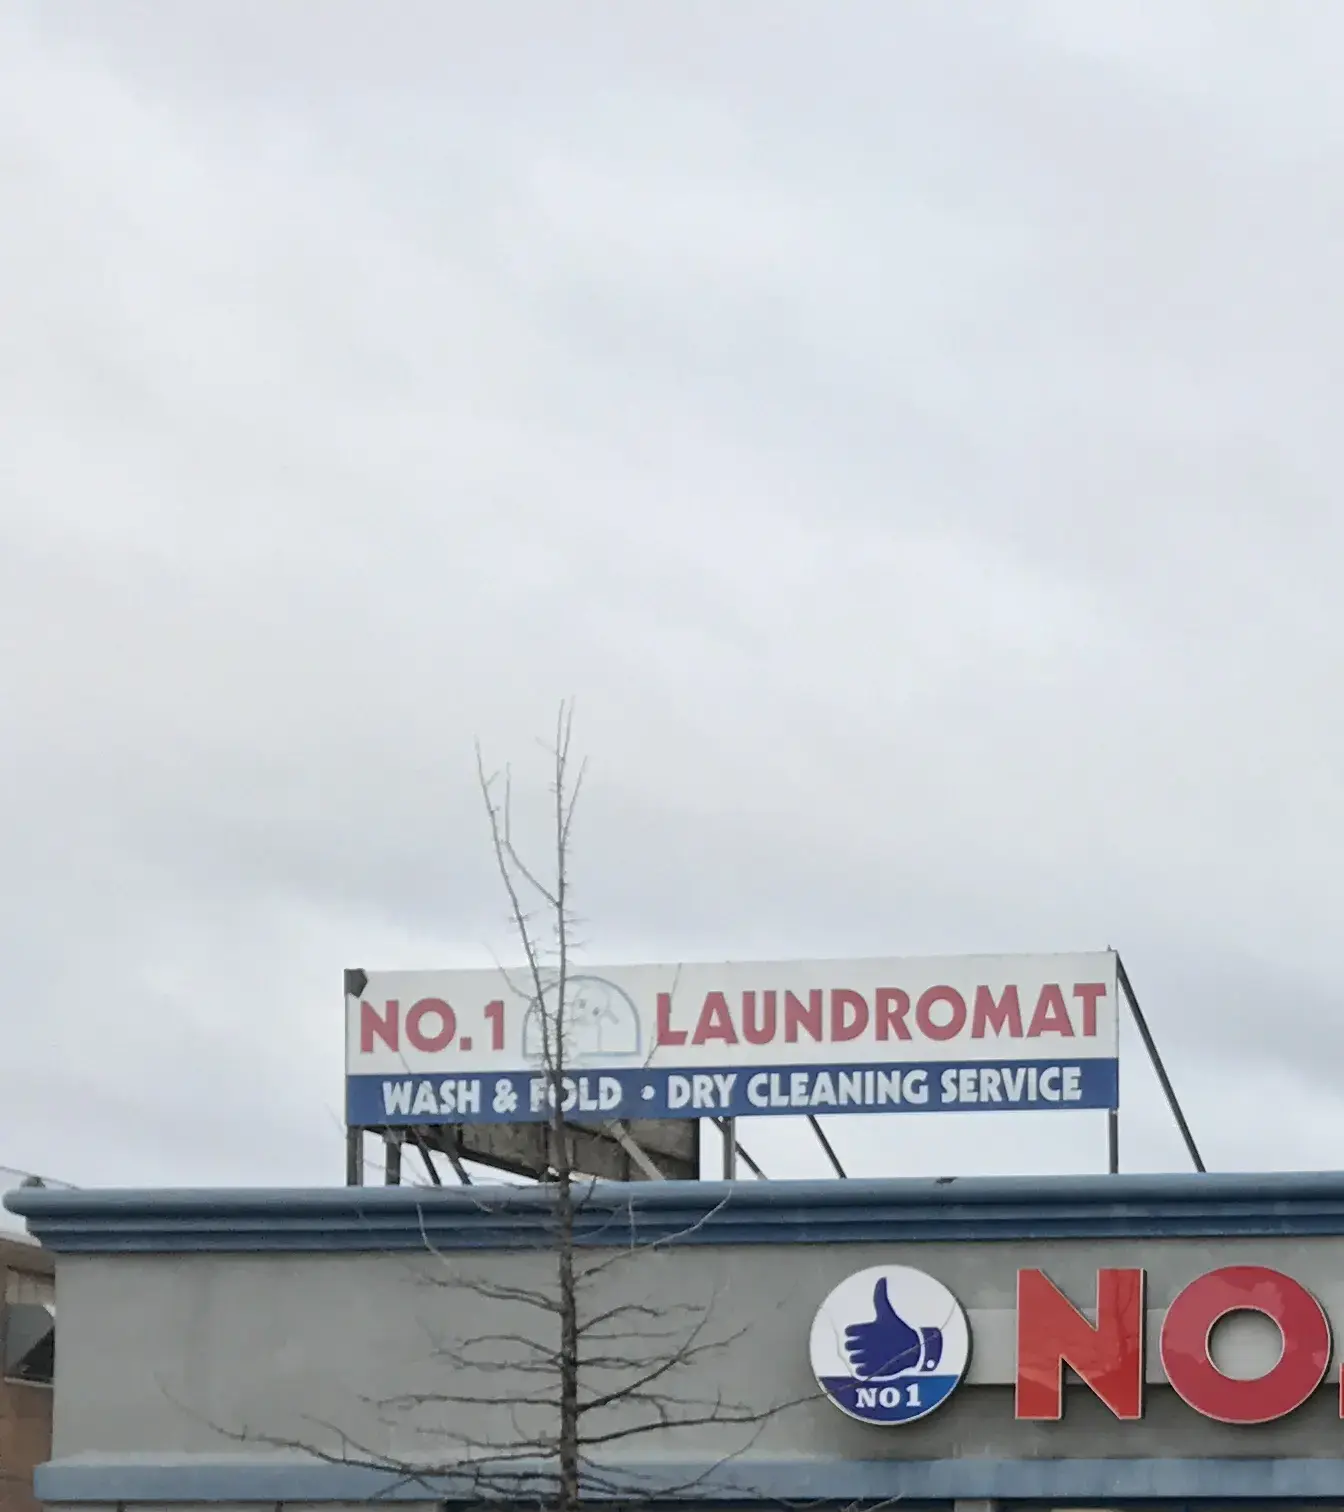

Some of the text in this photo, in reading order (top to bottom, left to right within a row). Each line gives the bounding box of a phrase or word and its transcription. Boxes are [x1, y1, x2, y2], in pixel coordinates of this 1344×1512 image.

[360, 983, 1107, 1053] NO.1 LAUNDROMAT
[382, 1066, 1082, 1116] WASH & FOLD DRY CLEANING SERVICE
